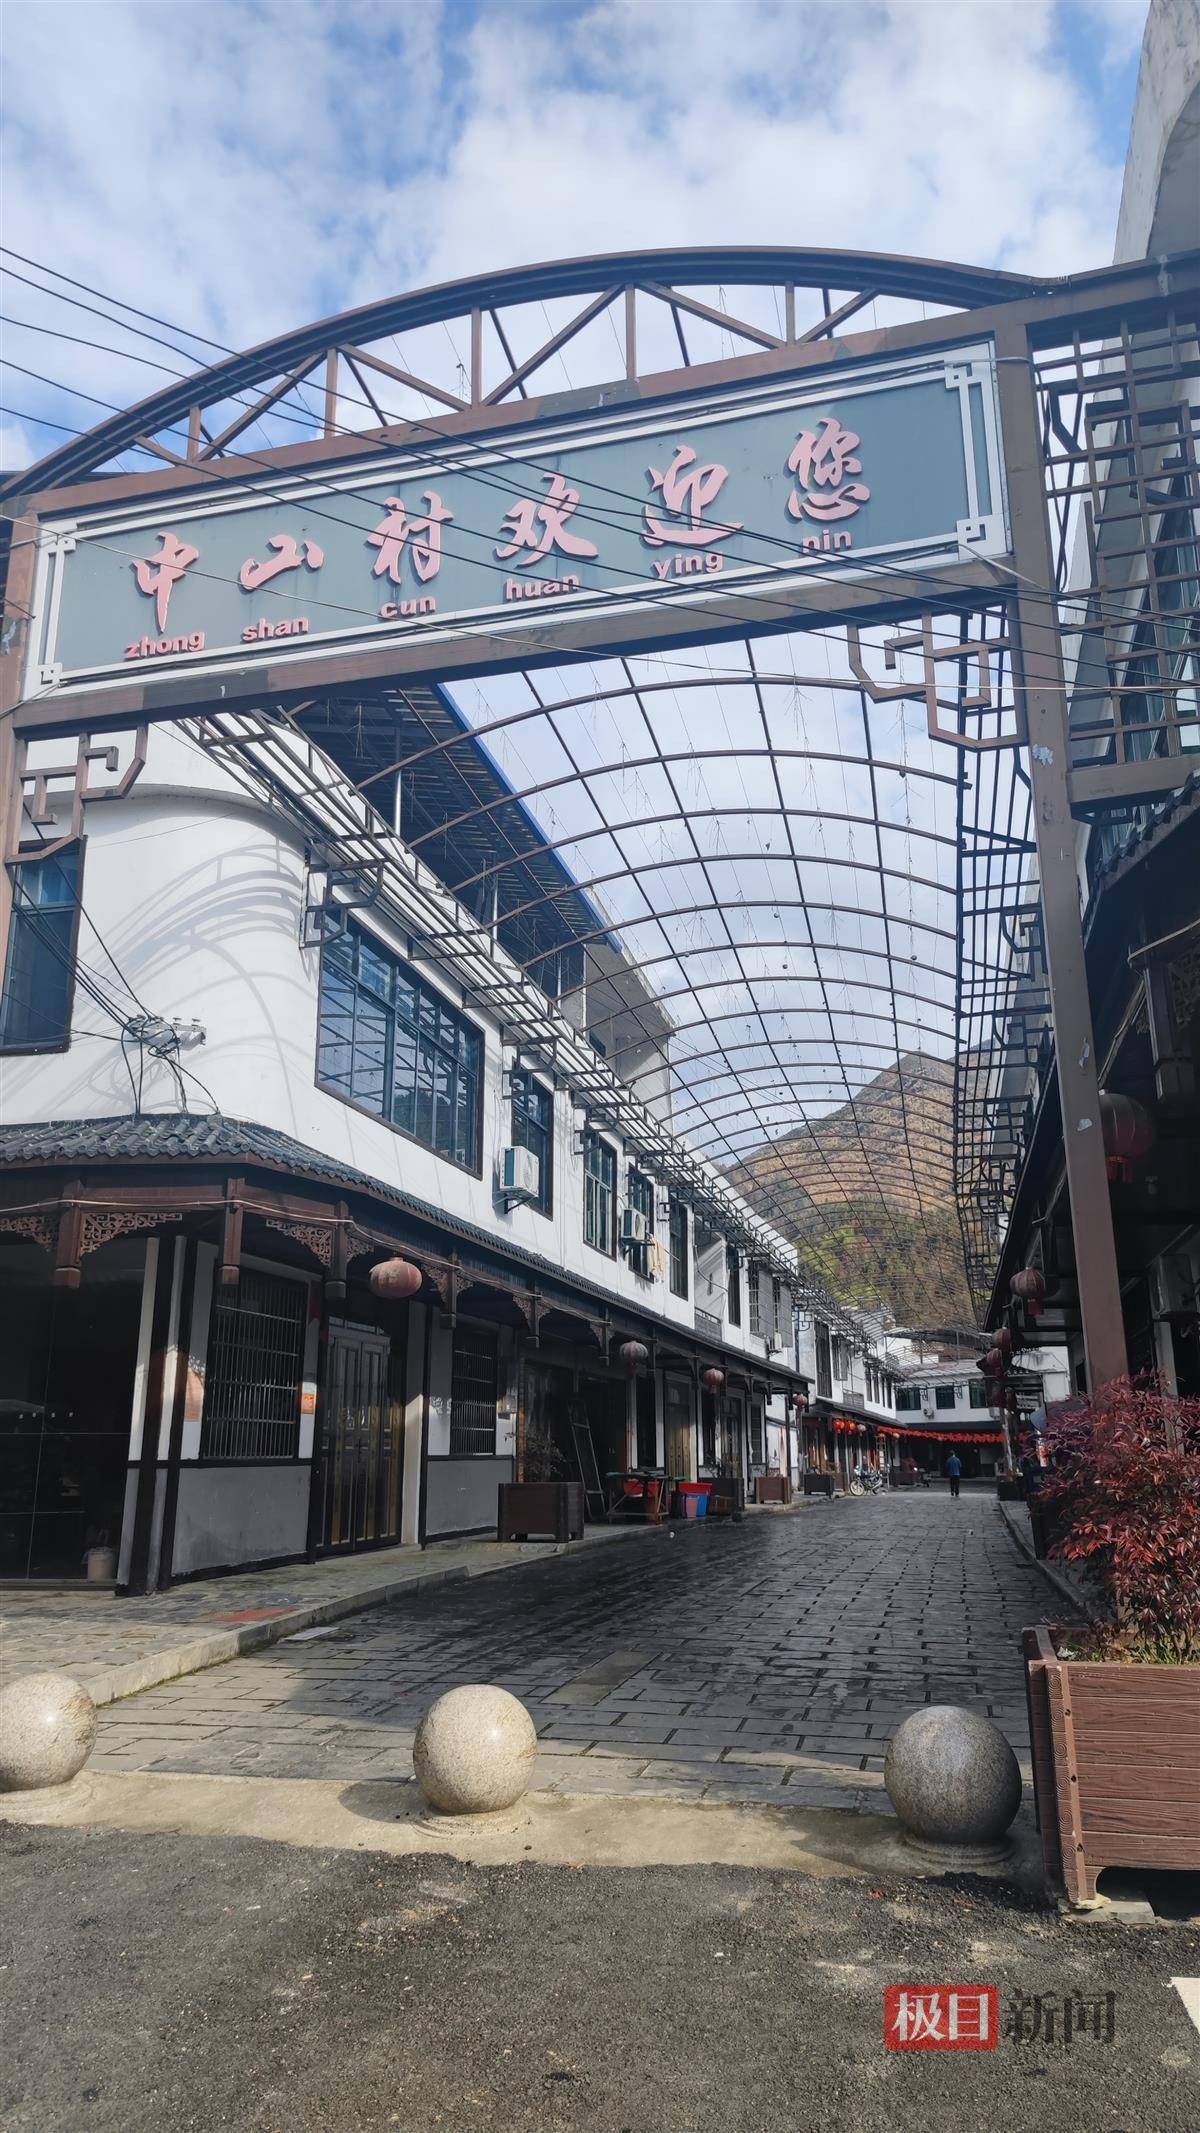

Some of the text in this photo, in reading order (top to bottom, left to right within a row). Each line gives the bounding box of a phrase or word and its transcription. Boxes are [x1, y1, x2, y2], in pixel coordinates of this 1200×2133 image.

[124, 528, 852, 660] zhong shan cun huan ying nin
[132, 417, 870, 633] 中山村欢迎您
